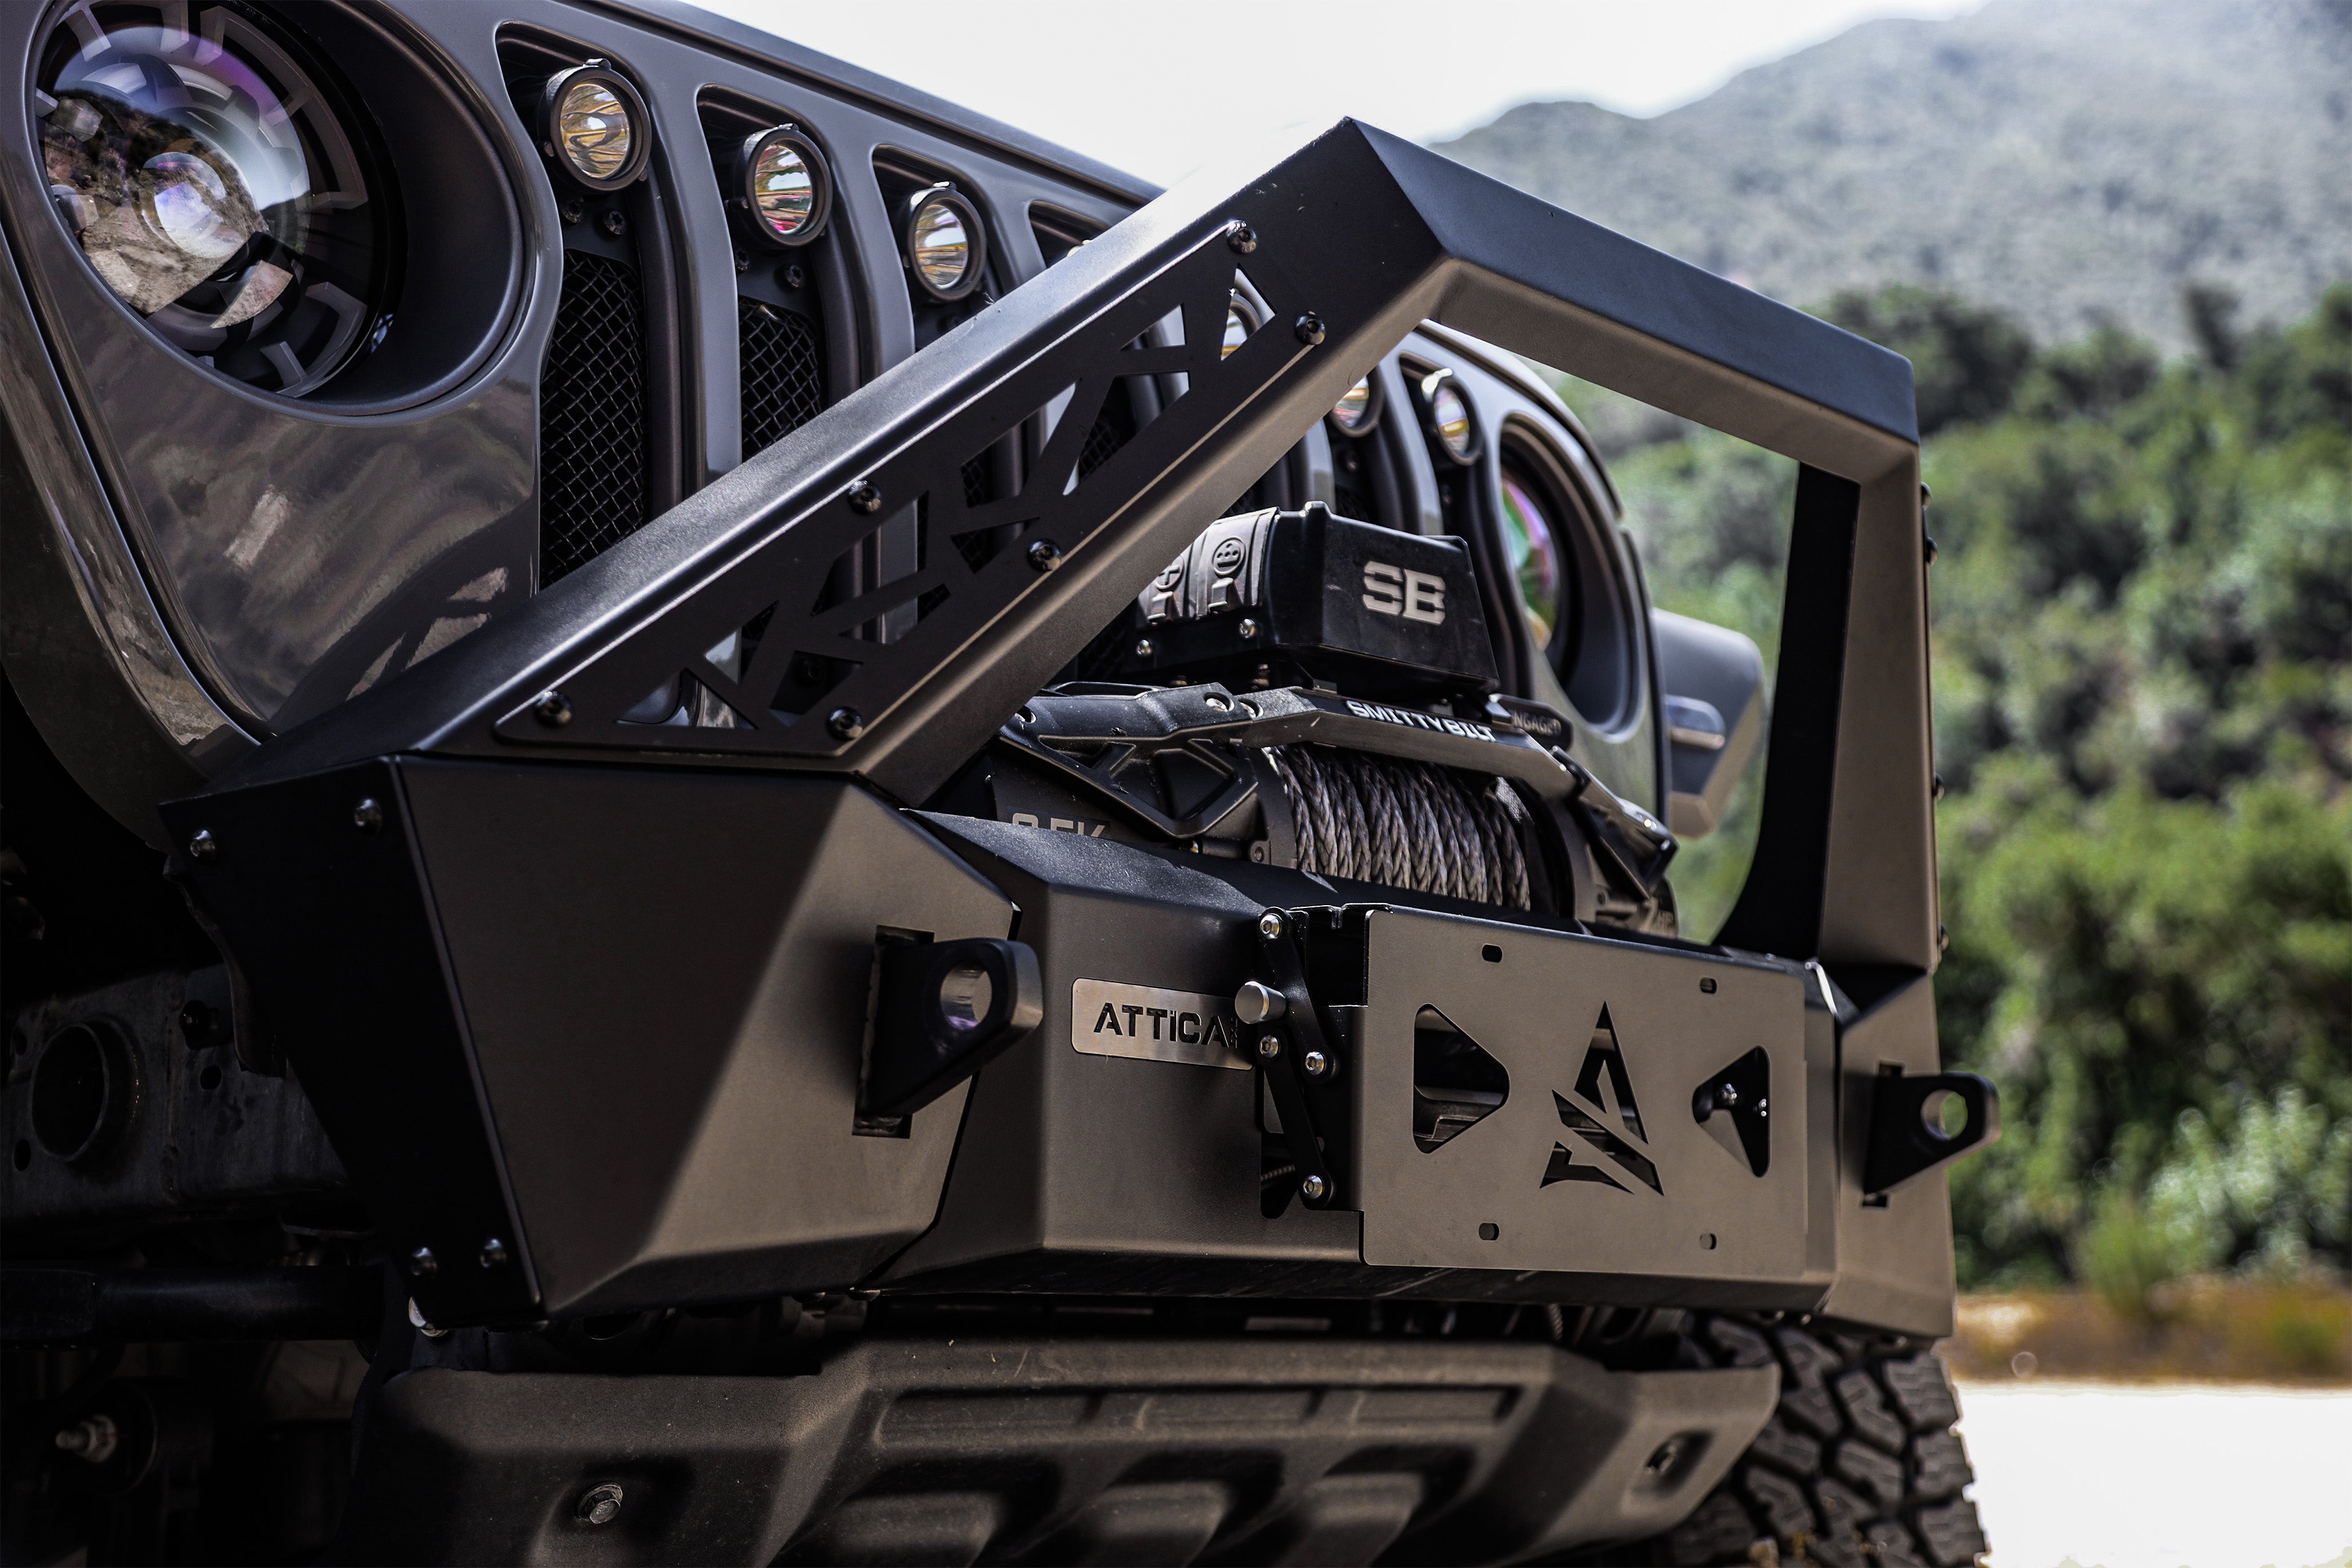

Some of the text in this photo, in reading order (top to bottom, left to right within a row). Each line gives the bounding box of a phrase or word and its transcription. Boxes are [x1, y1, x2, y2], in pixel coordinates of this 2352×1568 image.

[1362, 560, 1446, 625] SB
[1346, 700, 1496, 742] SMITTYBILT
[1511, 710, 1561, 734] NGAGED
[1093, 1003, 1230, 1048] ATTICA
